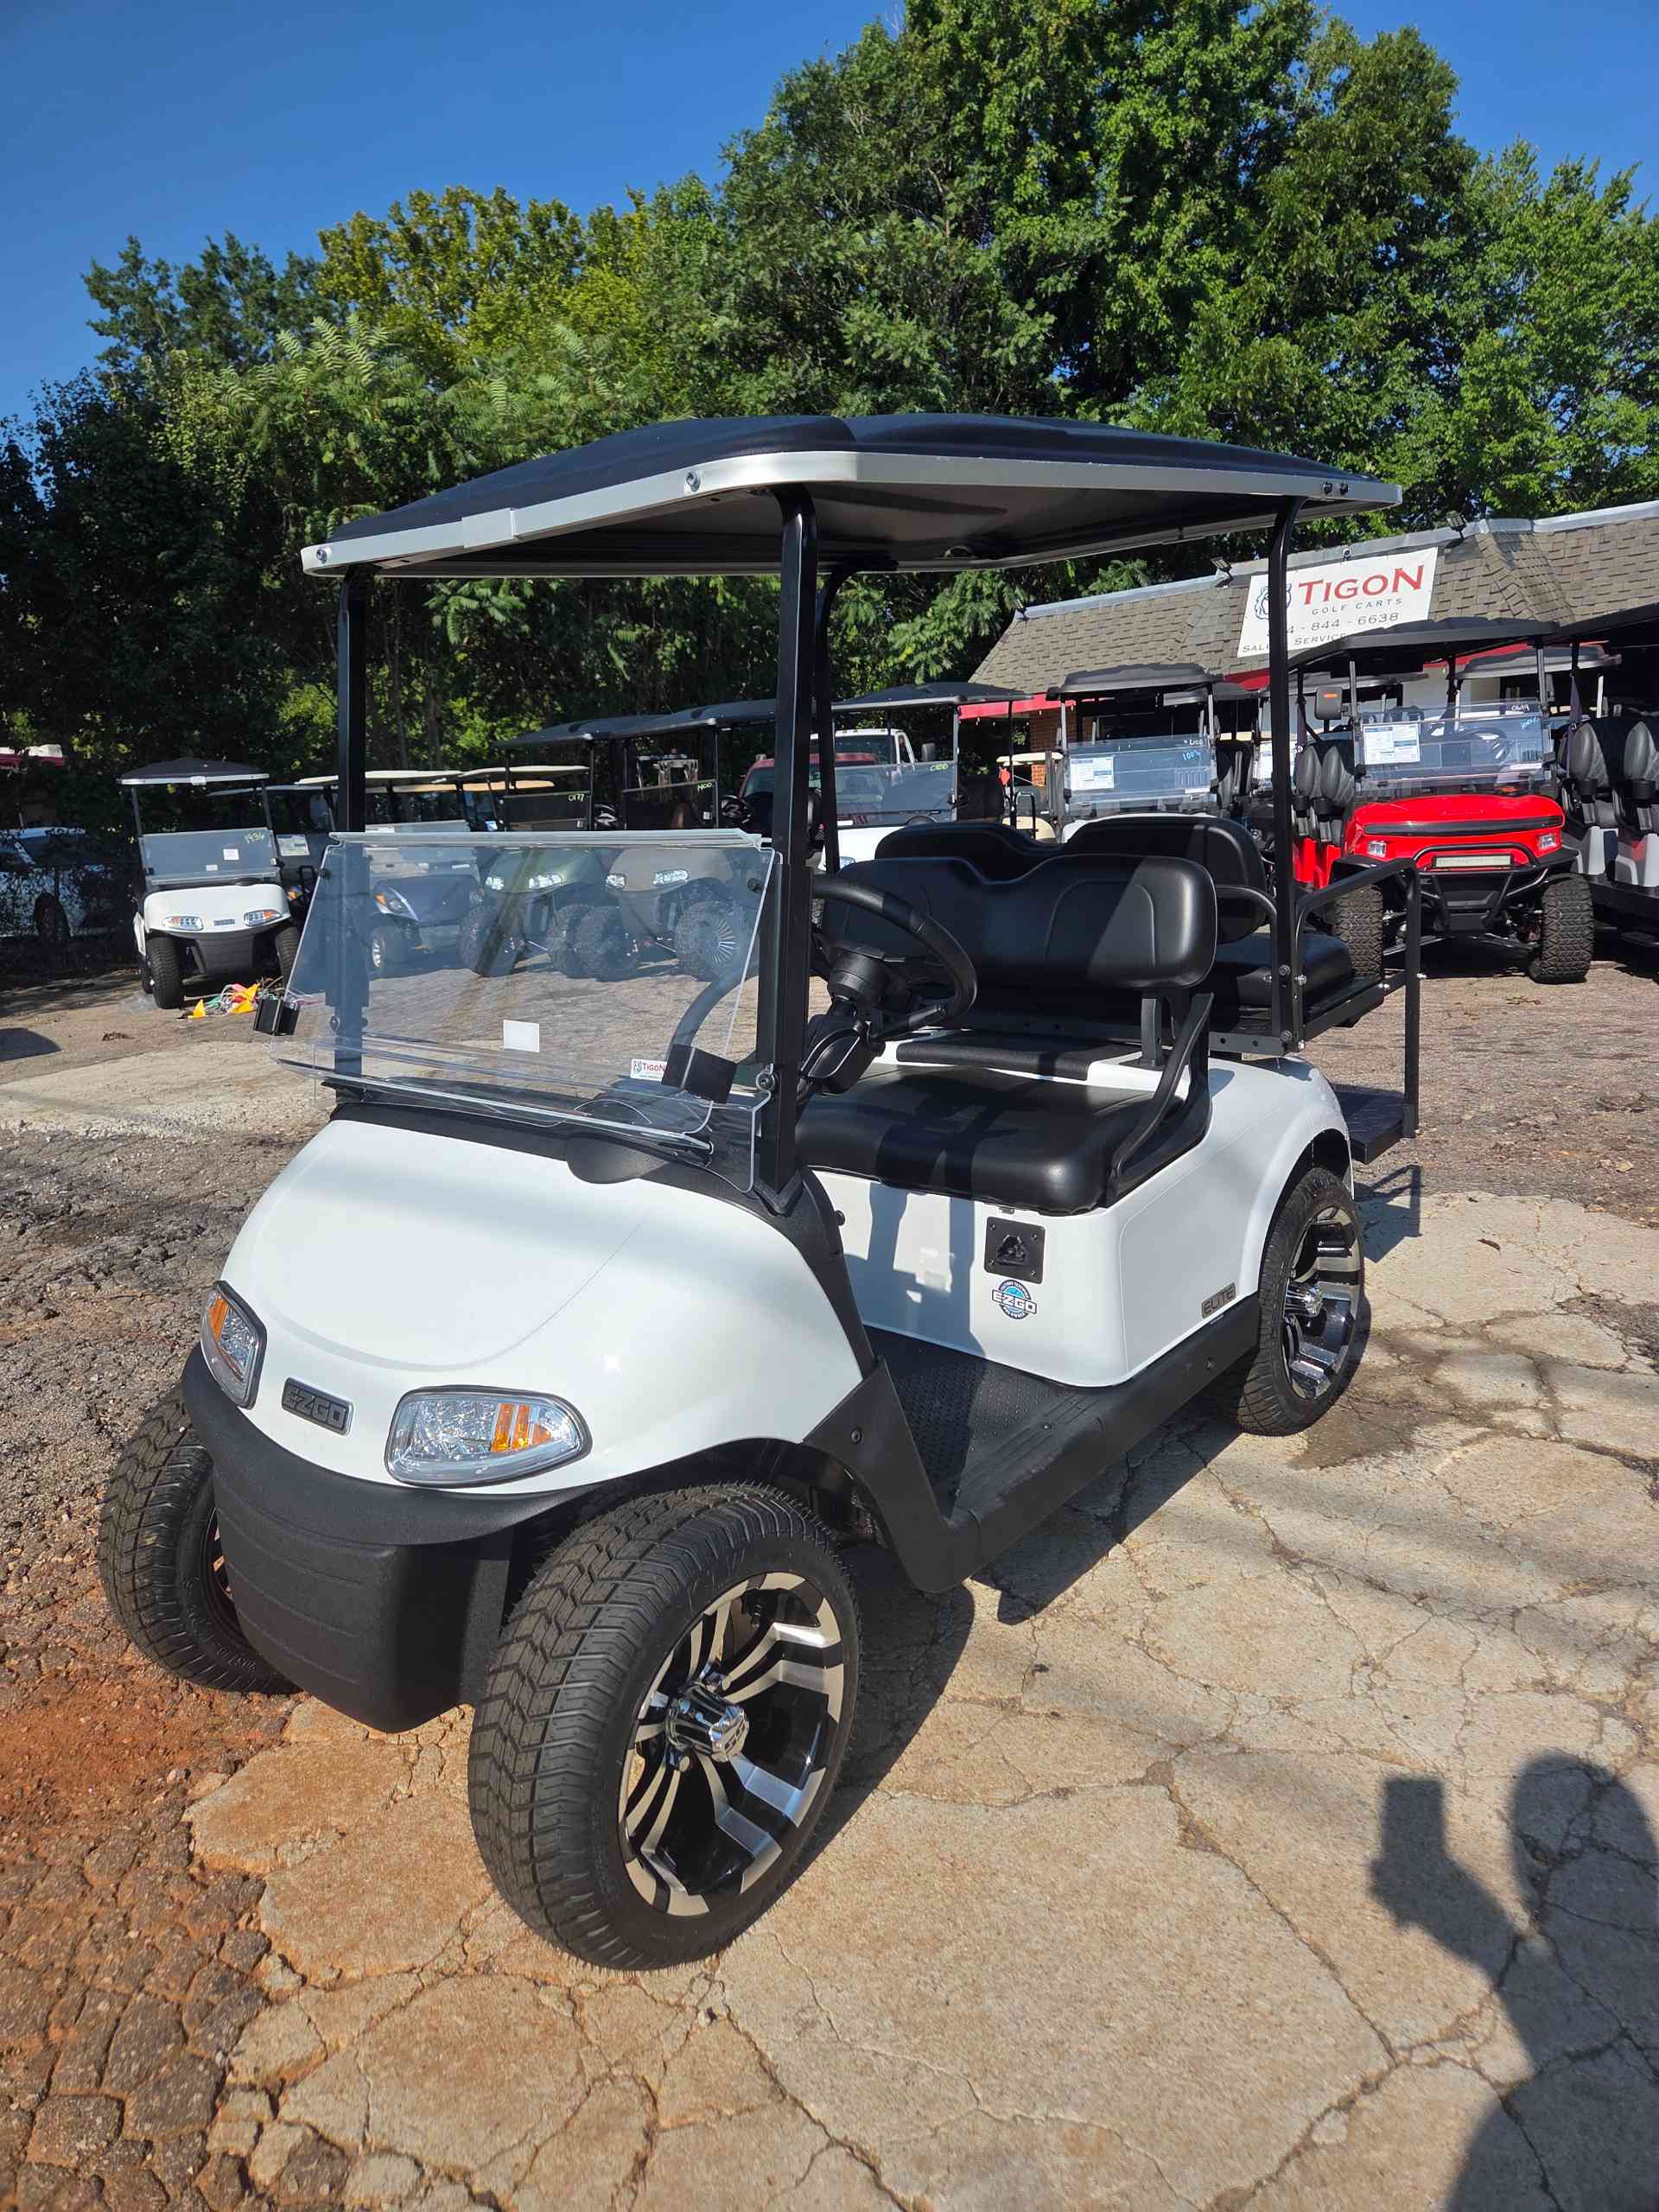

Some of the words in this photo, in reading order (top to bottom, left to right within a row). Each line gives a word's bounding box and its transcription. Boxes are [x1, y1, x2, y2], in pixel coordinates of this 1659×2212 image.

[1298, 564, 1424, 605] TIGON
[1312, 604, 1348, 615] GOLF
[1356, 597, 1403, 609] CARTS
[1311, 619, 1340, 631] 844
[1357, 612, 1400, 626] 6638
[995, 1291, 1036, 1313] EZGO
[1204, 1285, 1235, 1313] ELITE
[283, 1383, 346, 1429] EZGO
